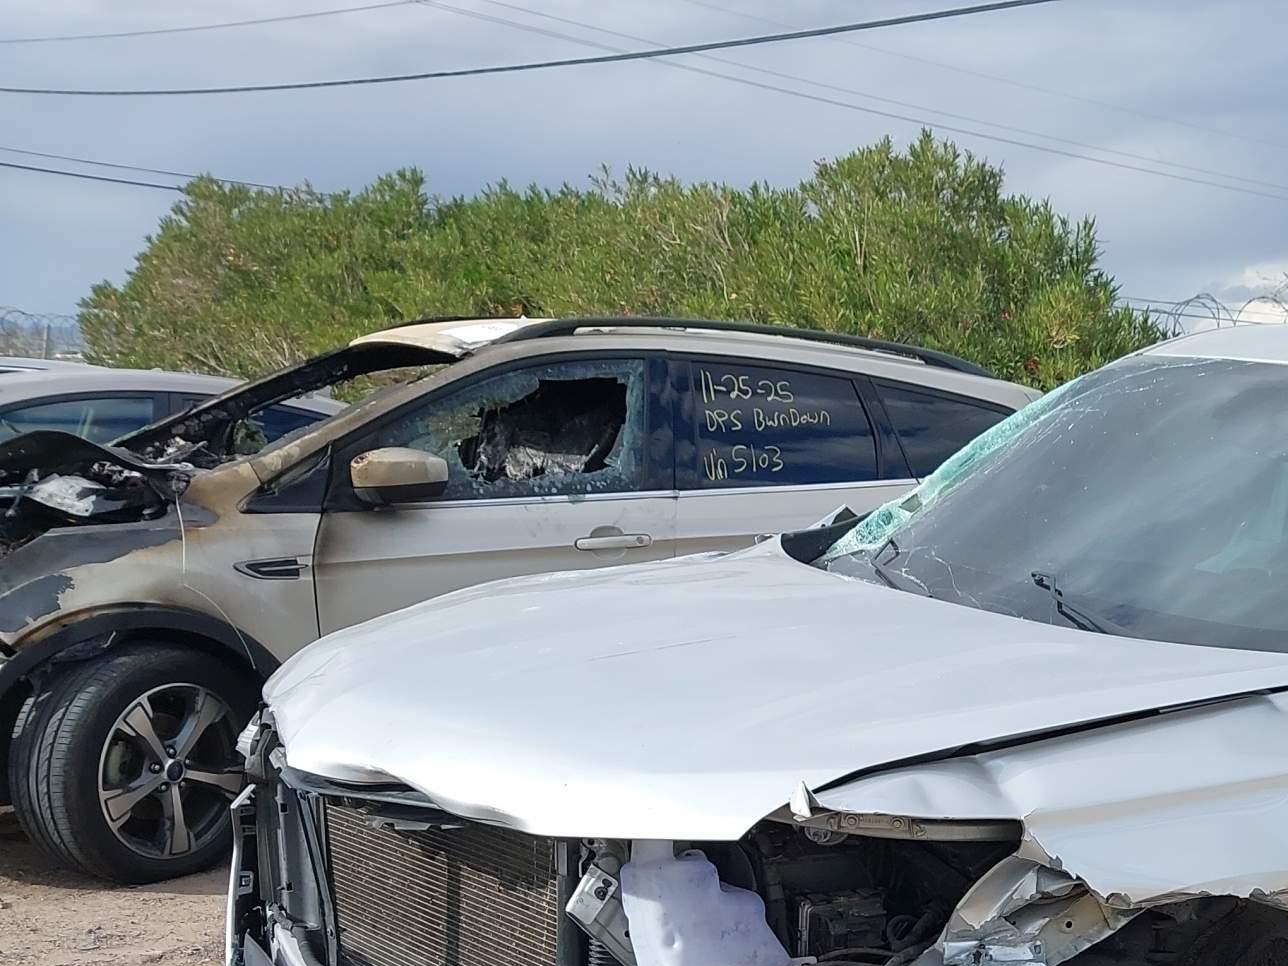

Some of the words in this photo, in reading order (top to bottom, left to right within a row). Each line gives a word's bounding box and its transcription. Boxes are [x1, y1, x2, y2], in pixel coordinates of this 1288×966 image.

[700, 368, 794, 403] 11-25-25
[705, 409, 743, 432] DPS
[731, 445, 784, 473] 5103
